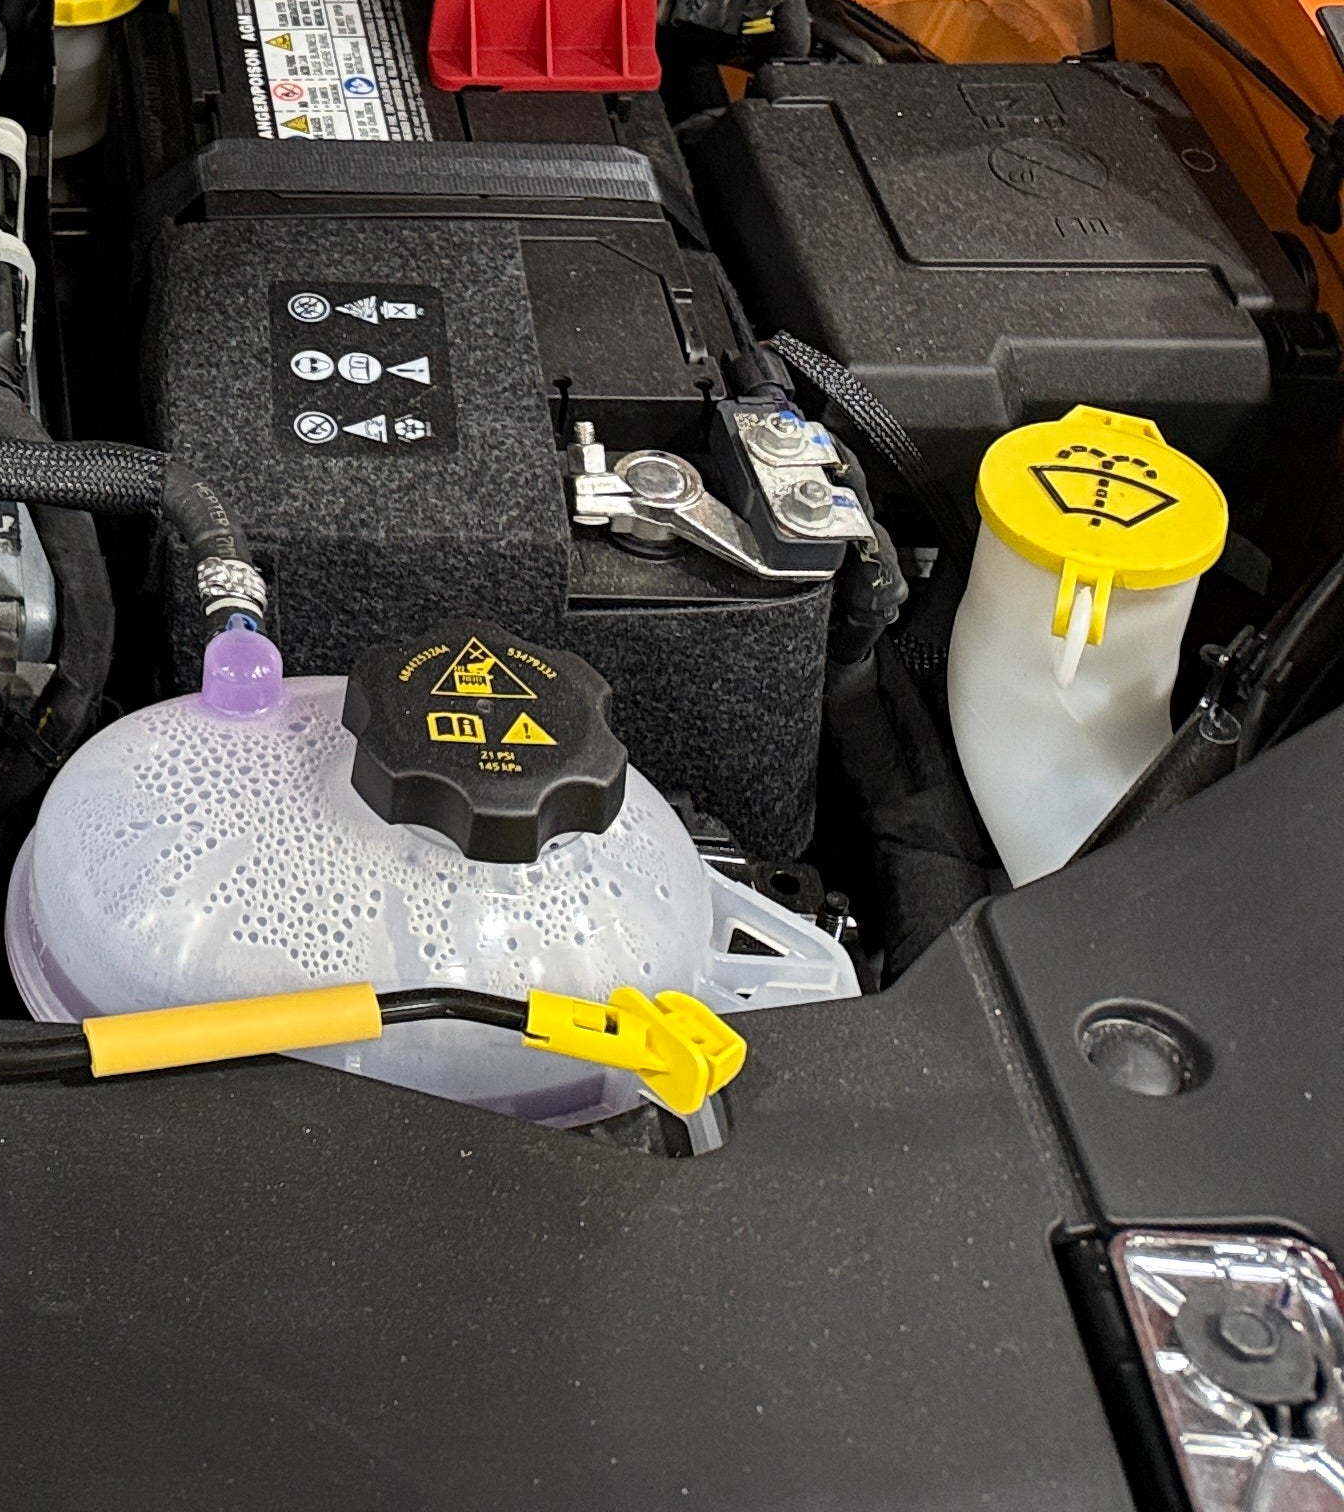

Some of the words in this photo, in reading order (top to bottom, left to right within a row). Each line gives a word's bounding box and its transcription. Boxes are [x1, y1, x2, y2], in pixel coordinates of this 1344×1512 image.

[237, 15, 256, 40] AGM
[246, 48, 273, 138] ANGER/POISON
[480, 751, 494, 761] 21
[497, 751, 516, 761] PSI
[478, 762, 500, 772] 145
[500, 762, 523, 773] kPa
